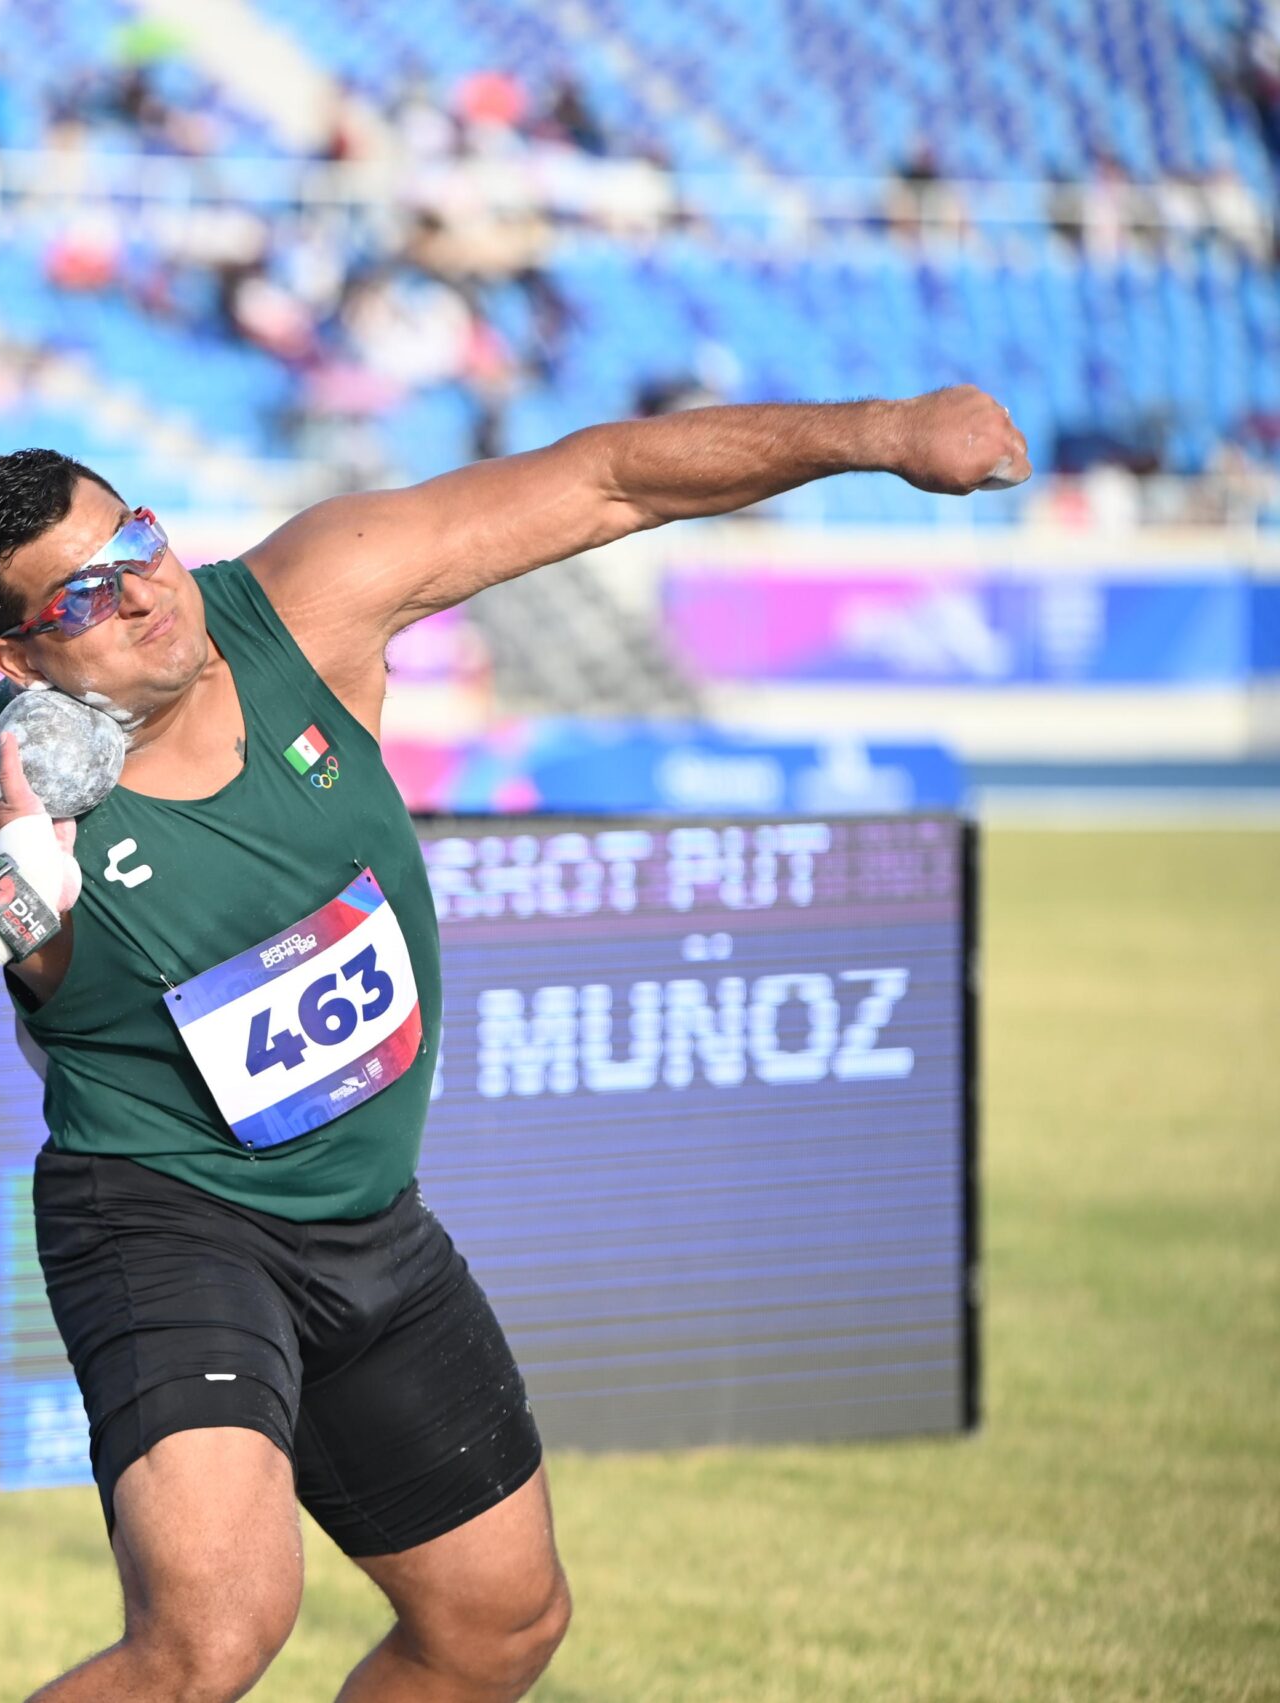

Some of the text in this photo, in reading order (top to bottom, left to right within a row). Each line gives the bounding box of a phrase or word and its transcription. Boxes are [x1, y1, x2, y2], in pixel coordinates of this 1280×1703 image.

[426, 830, 653, 920] SHOT
[666, 822, 830, 912] PUT
[3, 909, 37, 946] SPORT
[9, 897, 47, 941] DHE
[259, 934, 301, 959] SANTO
[262, 934, 316, 969] DOMINGO
[245, 943, 395, 1078] 463
